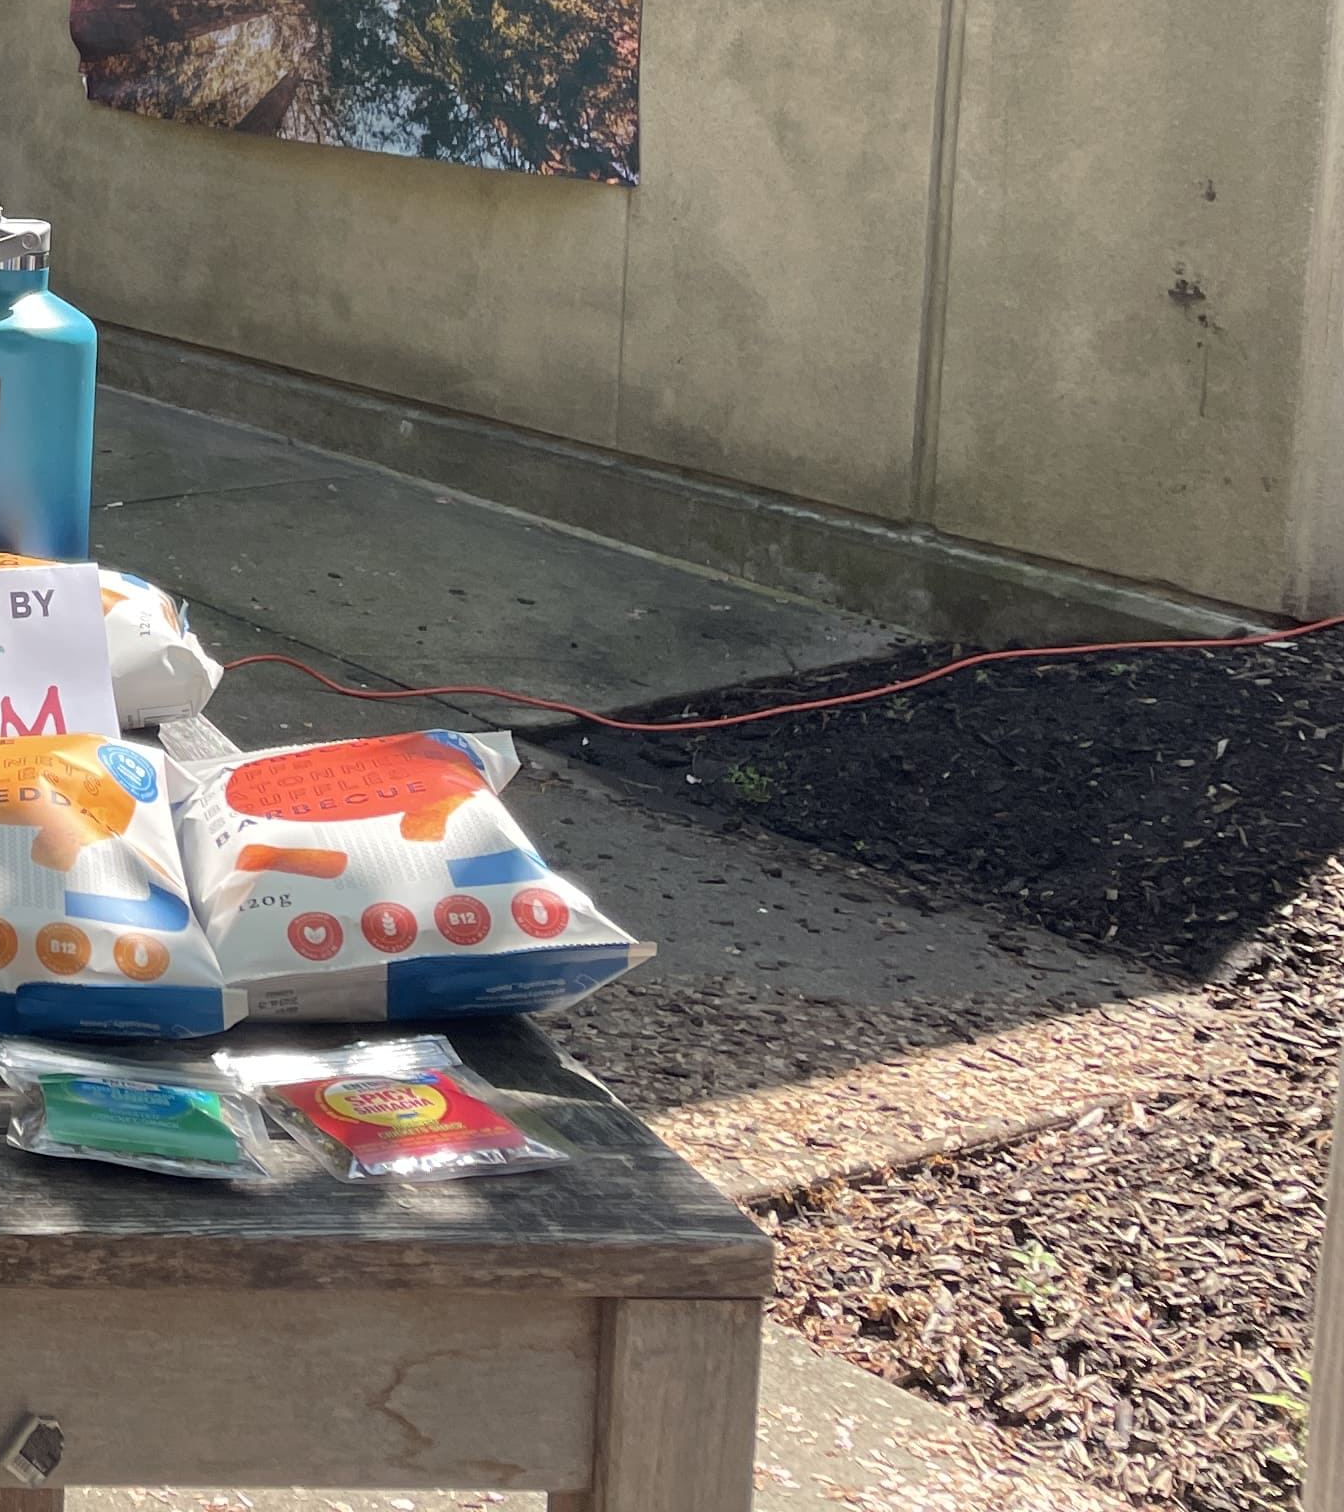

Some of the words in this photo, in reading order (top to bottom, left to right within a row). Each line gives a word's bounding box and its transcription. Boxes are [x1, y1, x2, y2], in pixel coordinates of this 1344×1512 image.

[10, 589, 55, 620] BY
[449, 909, 477, 926] B12
[50, 938, 78, 955] B12
[344, 1087, 418, 1107] SPICY
[354, 1096, 435, 1117] SRIRACHA
